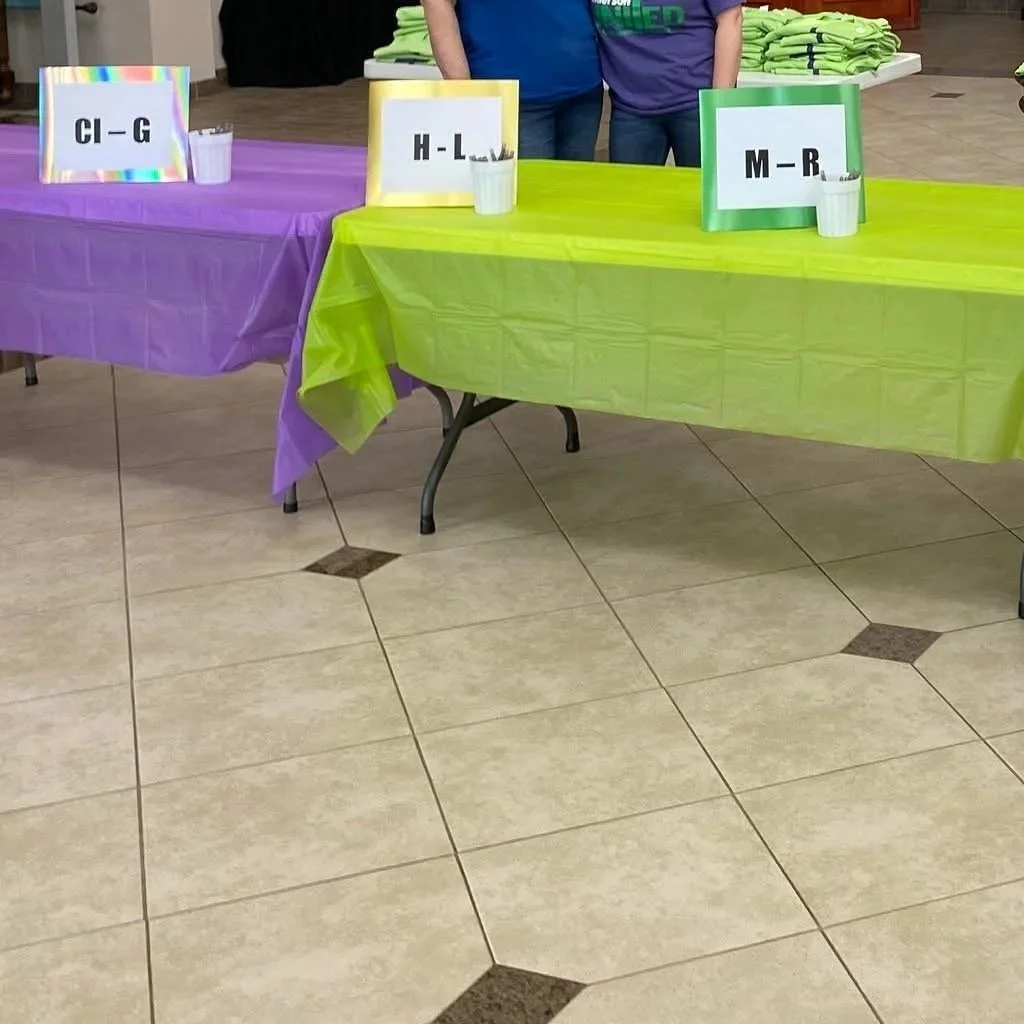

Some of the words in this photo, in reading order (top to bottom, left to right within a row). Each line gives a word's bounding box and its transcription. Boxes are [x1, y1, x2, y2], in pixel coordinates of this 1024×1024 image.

[133, 117, 150, 144] G
[413, 134, 430, 160] H
[454, 134, 466, 160] L
[745, 149, 769, 178] M
[802, 148, 820, 176] R
